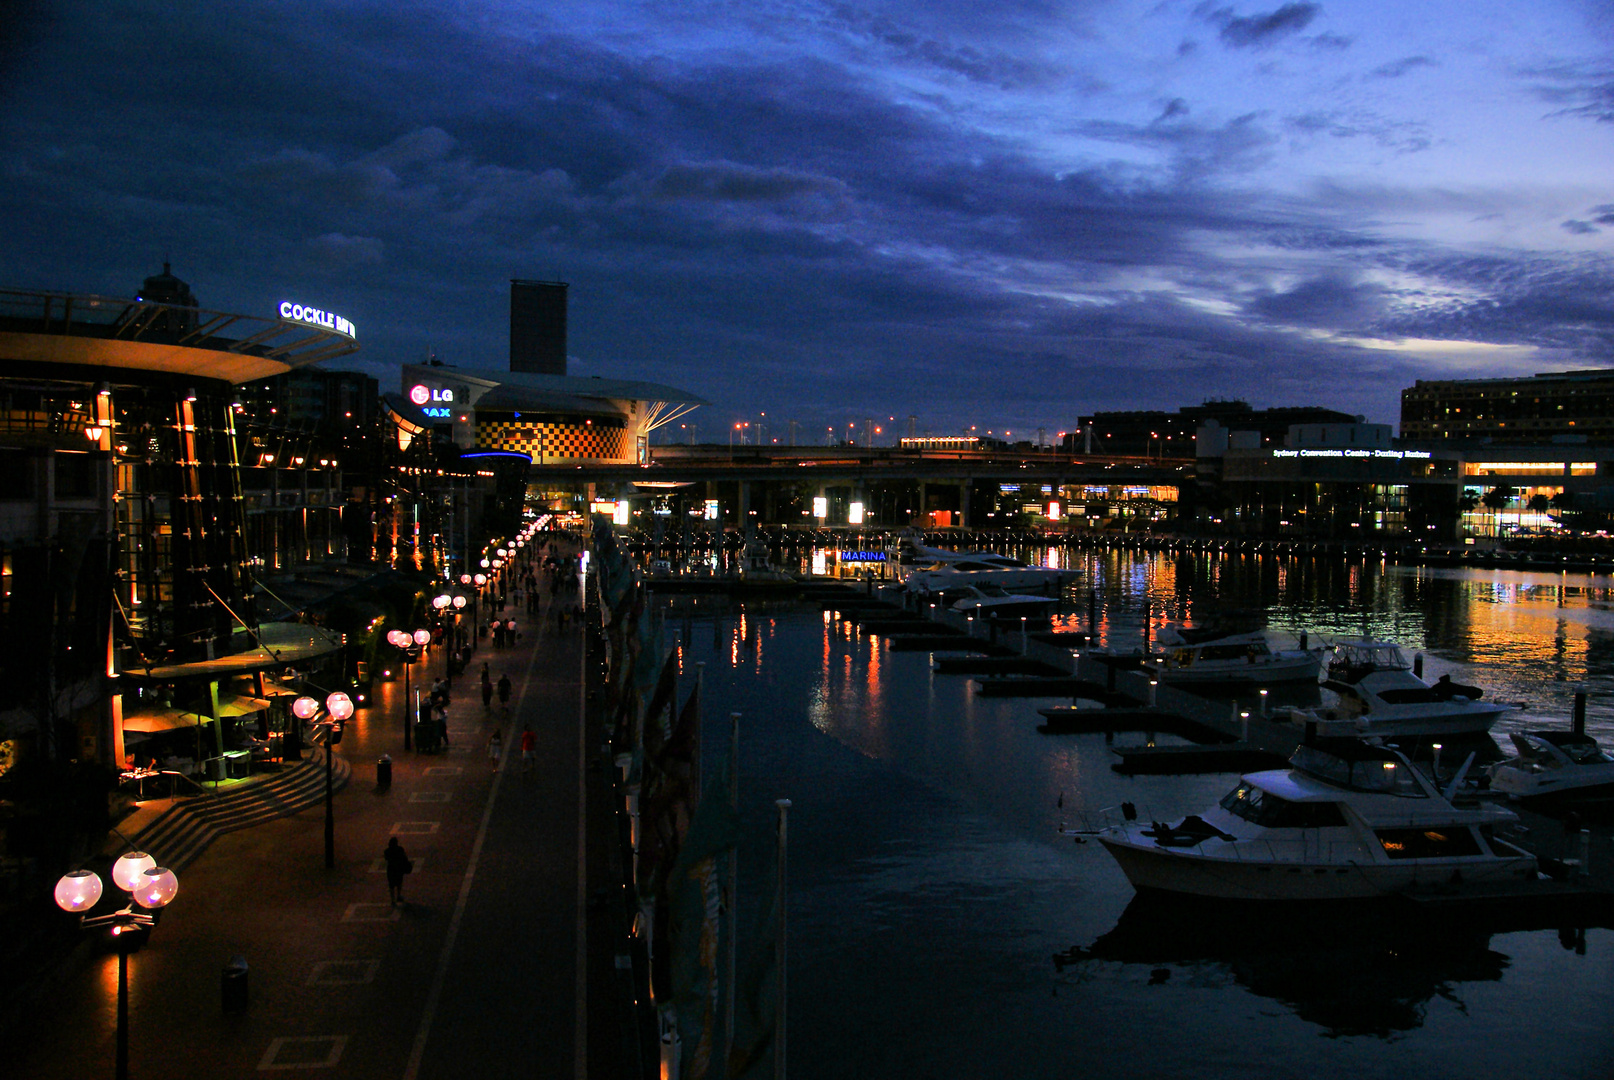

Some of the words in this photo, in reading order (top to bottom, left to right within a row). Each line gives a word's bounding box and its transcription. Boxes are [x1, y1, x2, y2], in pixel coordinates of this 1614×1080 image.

[279, 301, 335, 329] COCKLE
[432, 388, 454, 402] LG
[1273, 449, 1299, 458] Sydney
[1300, 449, 1344, 457] Convention
[1344, 449, 1370, 457] Centre
[1375, 449, 1404, 459] Darling
[1404, 450, 1431, 459] Harbour
[842, 551, 887, 561] MARINA
